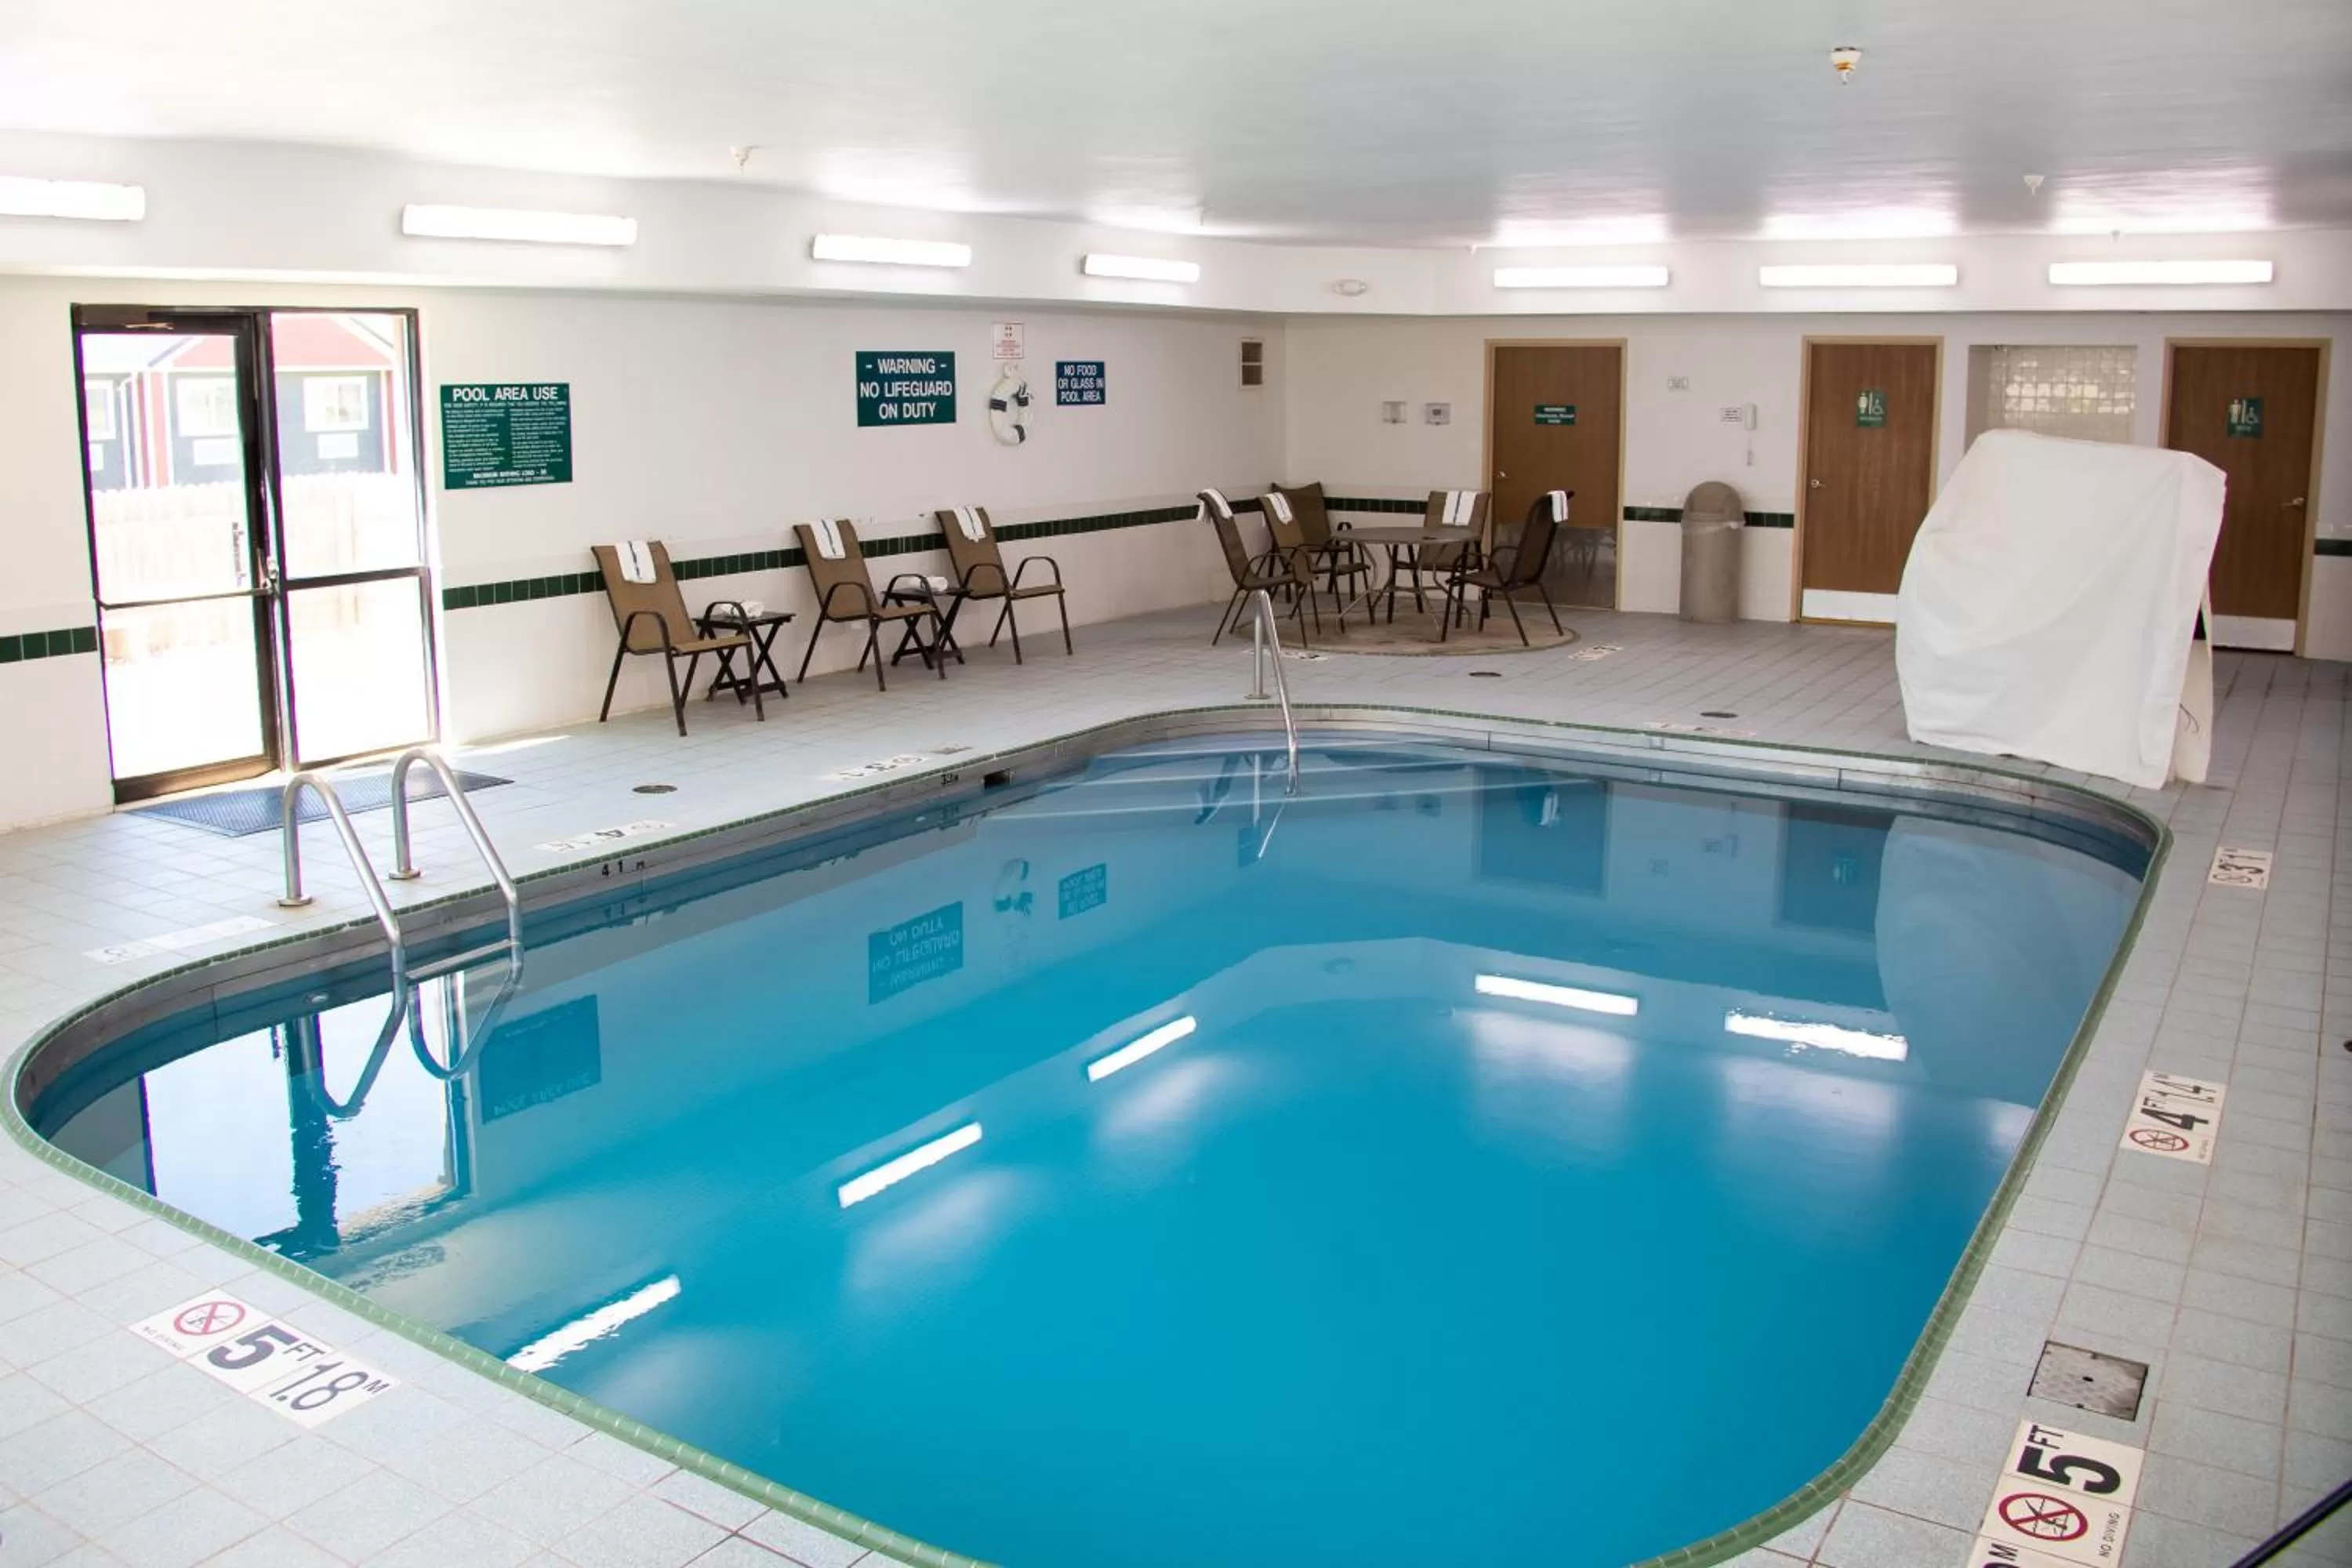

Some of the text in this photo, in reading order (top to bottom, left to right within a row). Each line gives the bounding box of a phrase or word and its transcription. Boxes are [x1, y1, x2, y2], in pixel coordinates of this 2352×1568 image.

[877, 358, 935, 374] WARNING
[1064, 365, 1098, 376] NO FOOD
[860, 380, 953, 398] NO LIFEGUARD
[1070, 377, 1094, 389] GLASS
[452, 386, 558, 401] POOL AREA USE
[1061, 390, 1081, 401] POOL
[879, 401, 936, 419] ON DUTY
[2140, 1107, 2209, 1131] 4
[207, 1324, 300, 1370] 5
[282, 1341, 326, 1362] FT
[363, 1379, 390, 1395] M
[2016, 1425, 2121, 1494] 5 FT
[1988, 1543, 2018, 1561] M
[2098, 1544, 2111, 1558] NO
